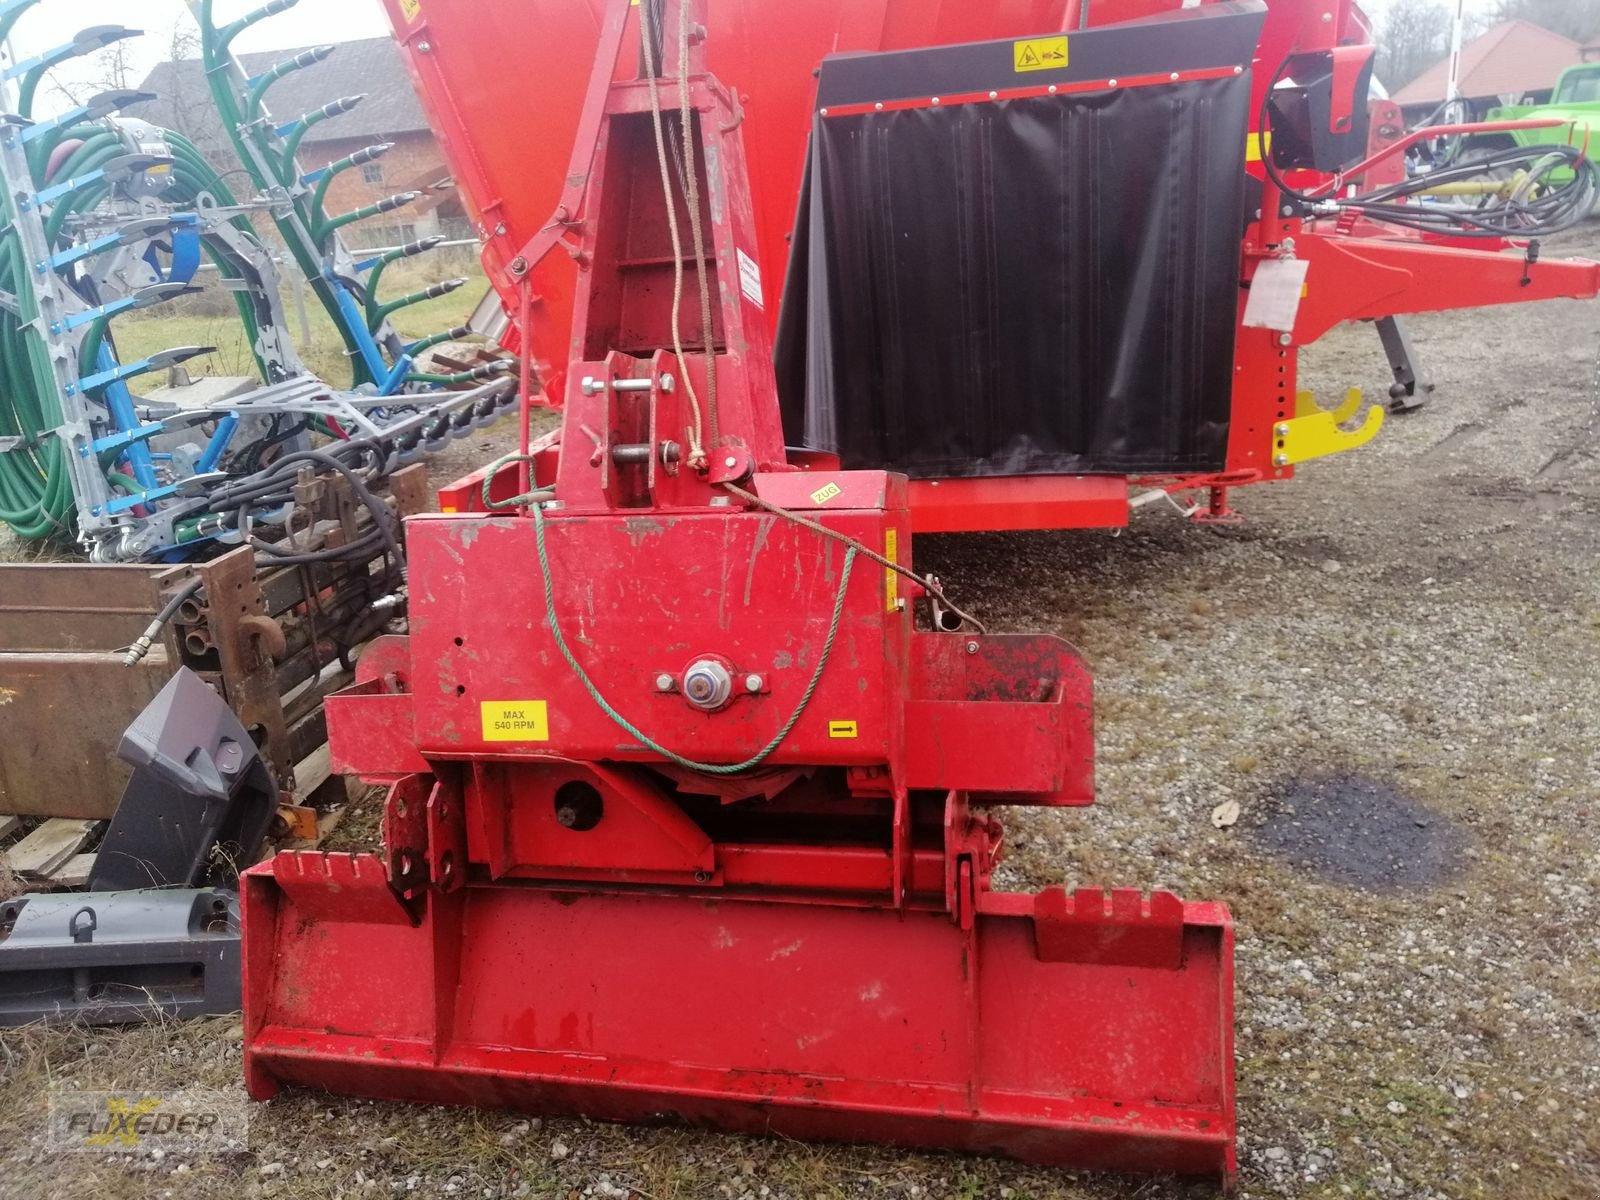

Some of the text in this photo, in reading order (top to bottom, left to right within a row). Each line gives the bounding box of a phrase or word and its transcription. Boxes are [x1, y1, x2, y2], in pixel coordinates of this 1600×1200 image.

[814, 486, 838, 502] ZUG
[503, 710, 525, 720] MAX
[494, 720, 535, 730] 540 RPM
